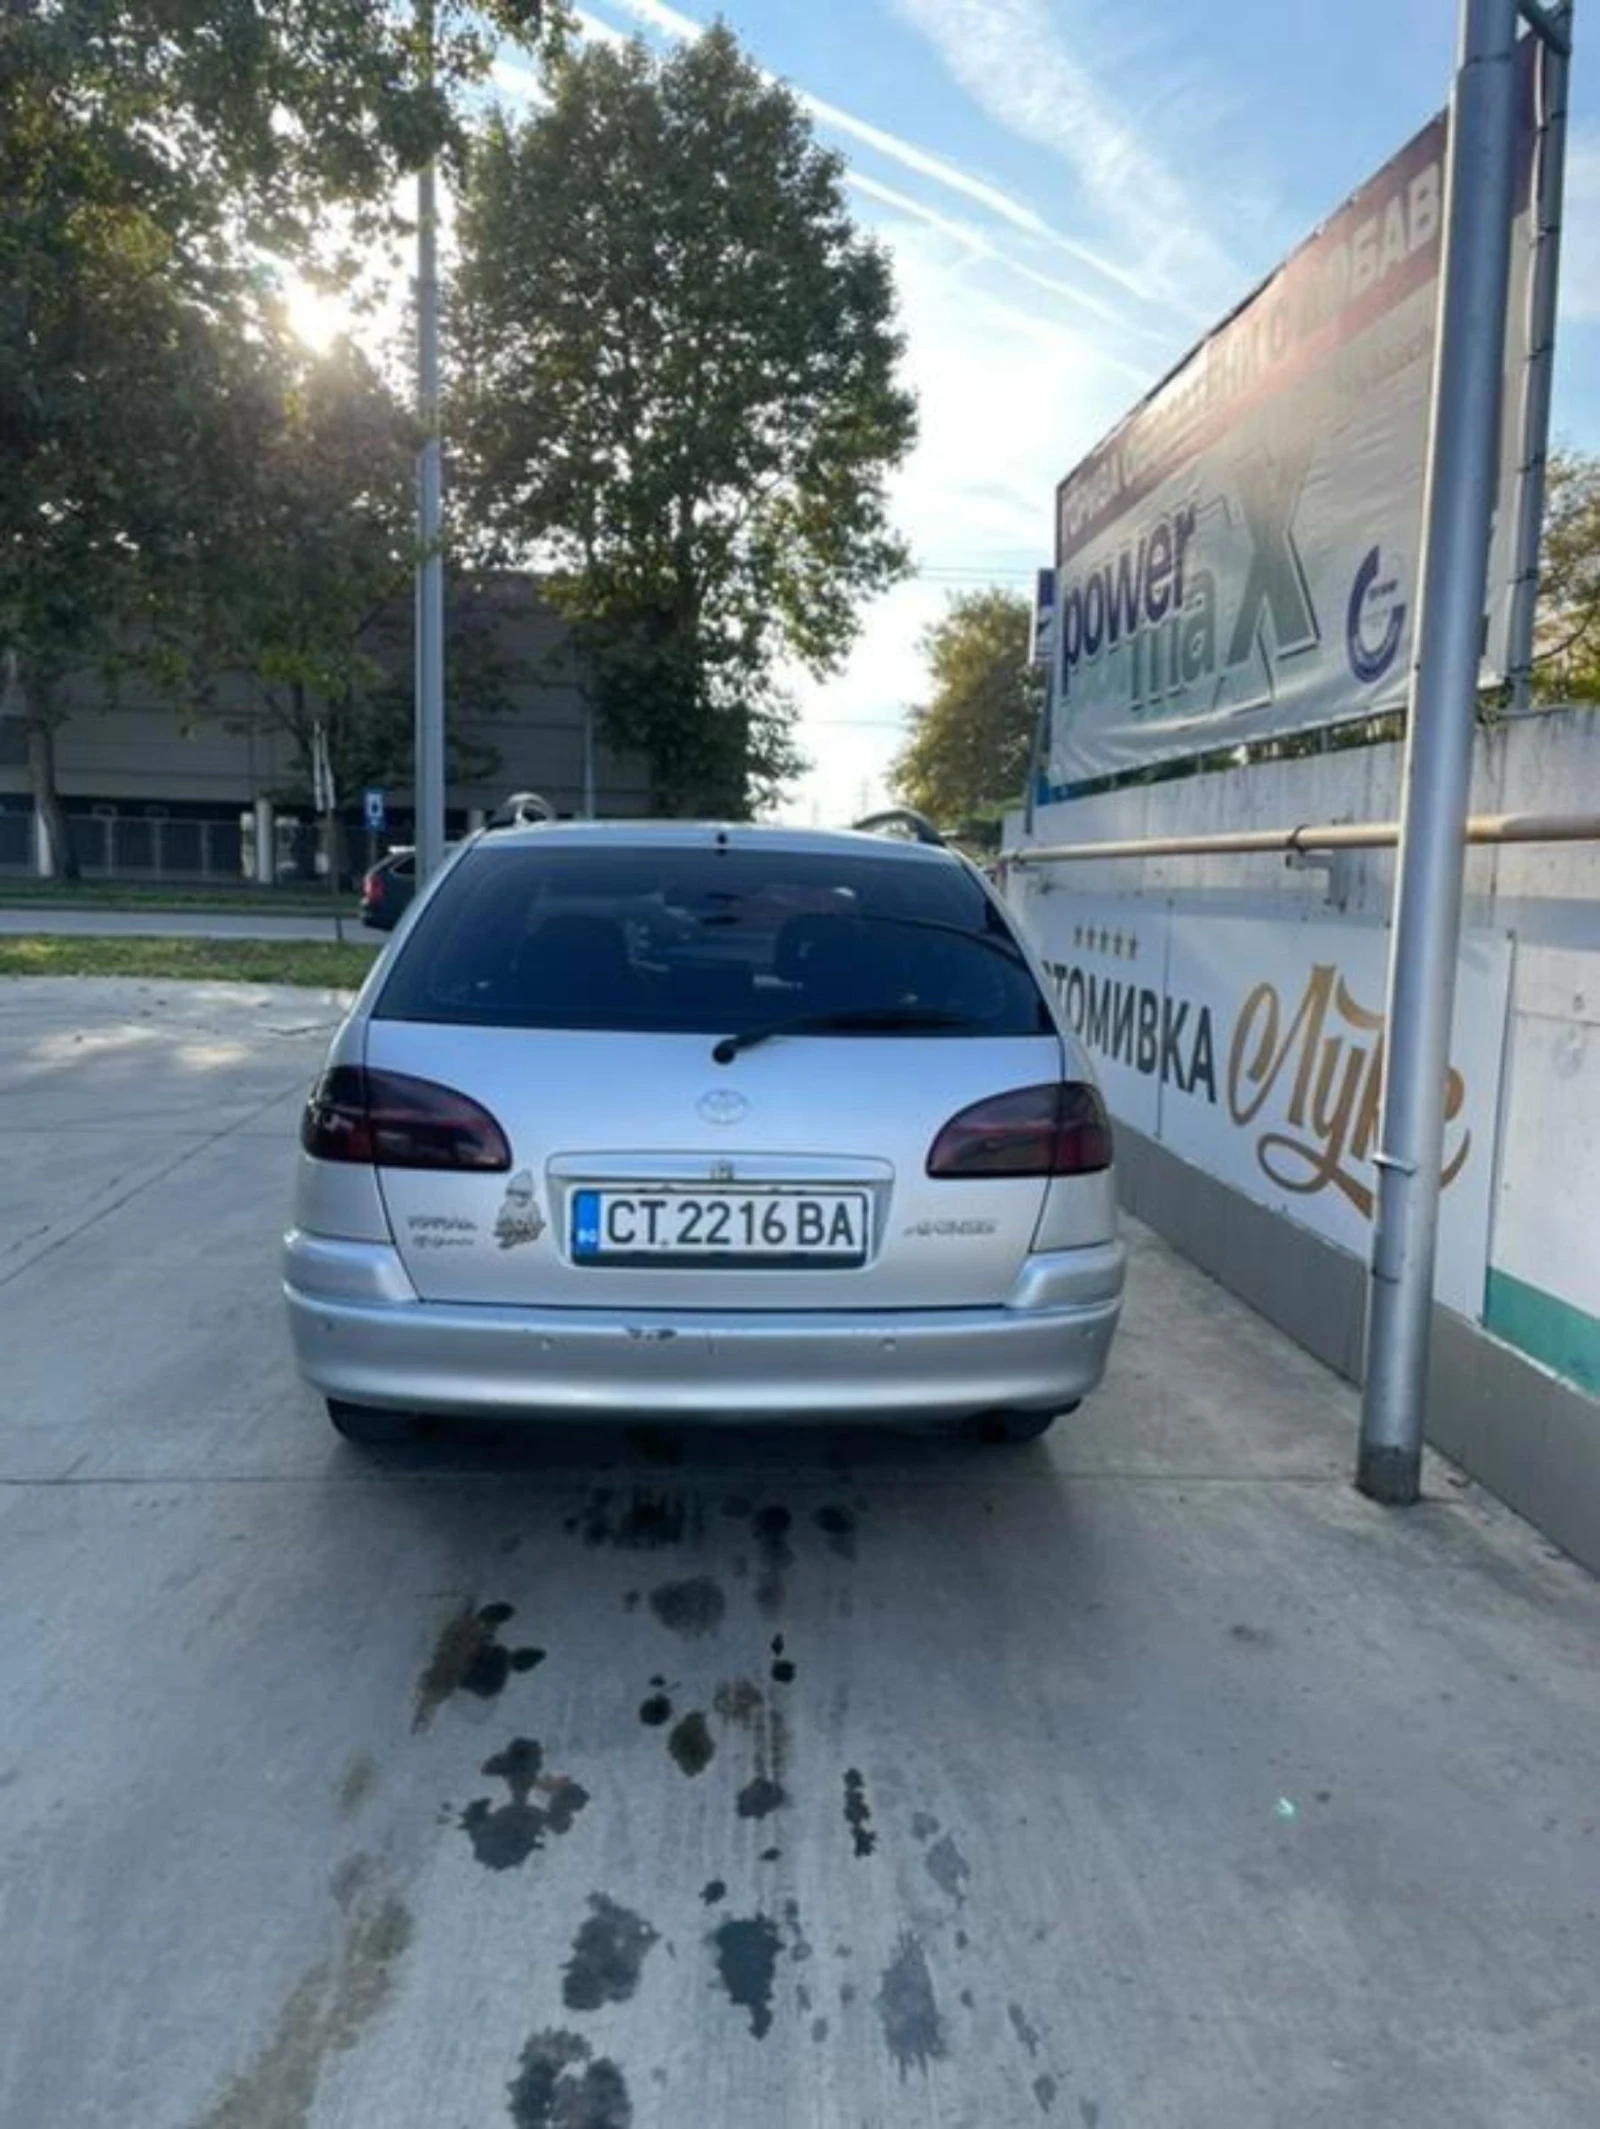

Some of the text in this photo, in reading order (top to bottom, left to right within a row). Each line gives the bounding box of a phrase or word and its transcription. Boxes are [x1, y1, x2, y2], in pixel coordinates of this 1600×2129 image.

[1061, 500, 1197, 698] power
[1041, 959, 1217, 1105] ТОМИВКА
[607, 1199, 667, 1245] CT
[676, 1200, 788, 1245] 2216
[796, 1201, 854, 1246] BA
